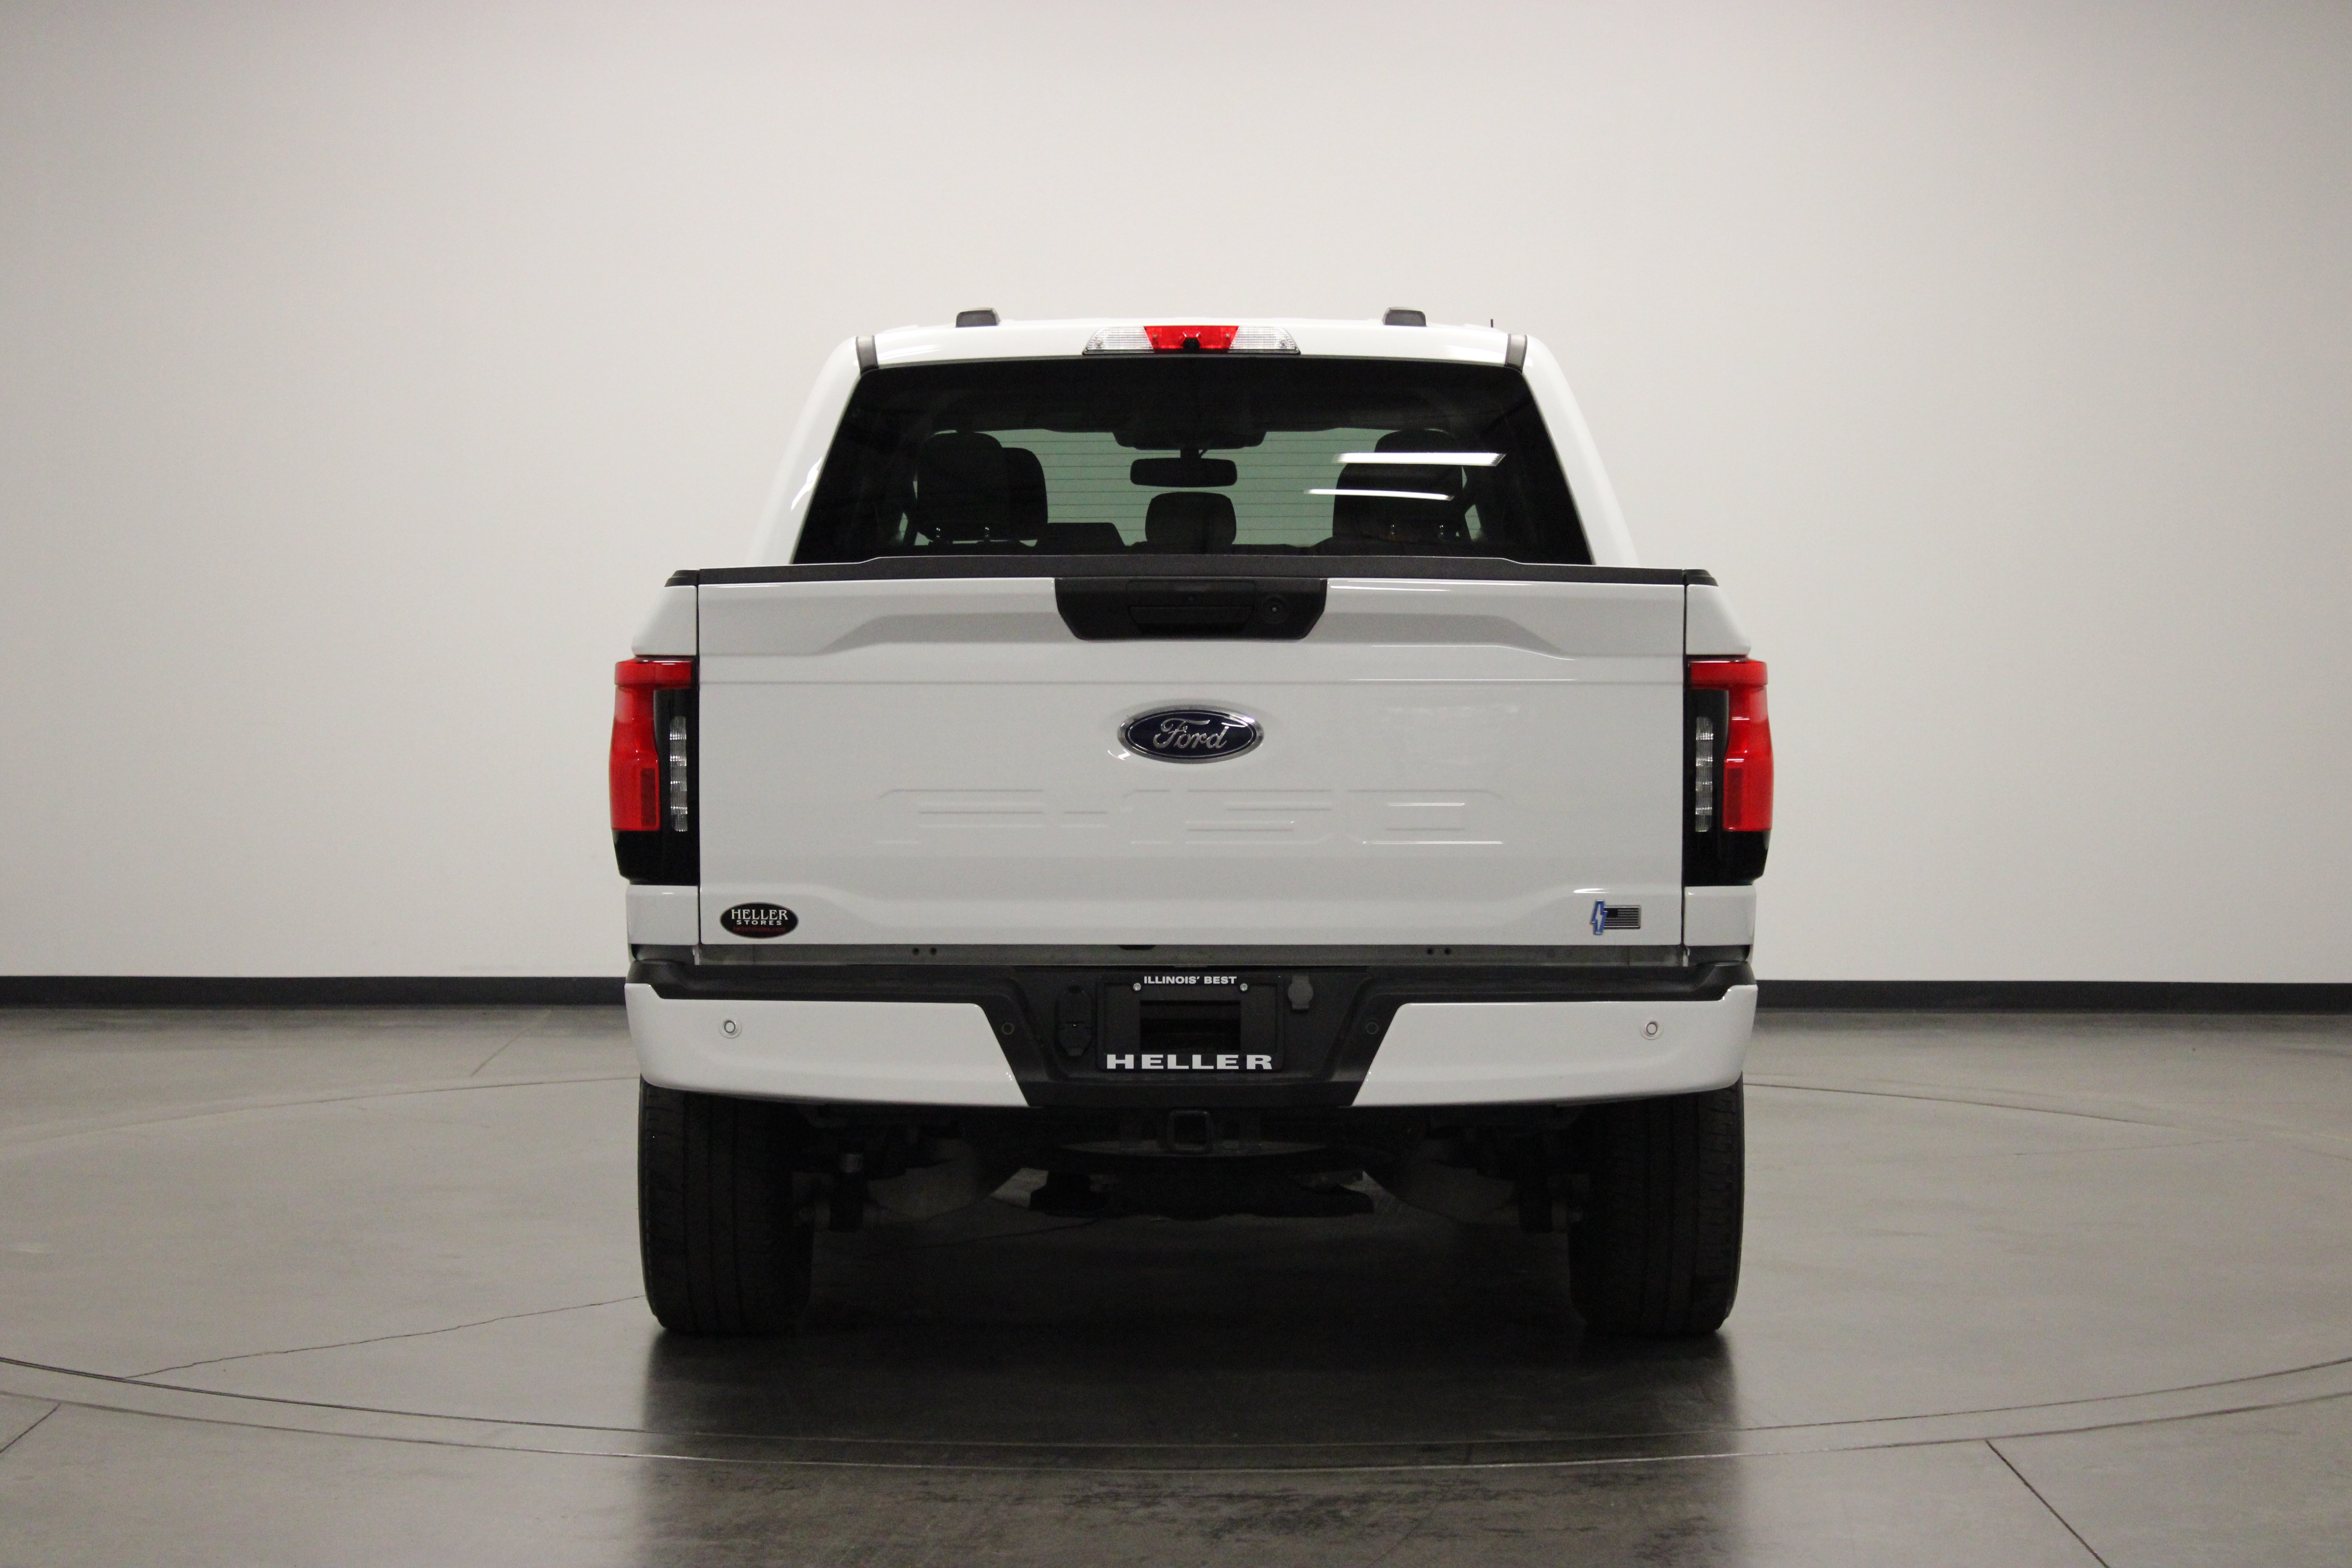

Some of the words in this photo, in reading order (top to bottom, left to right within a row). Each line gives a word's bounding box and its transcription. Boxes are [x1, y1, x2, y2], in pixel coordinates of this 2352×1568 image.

[1153, 718, 1229, 749] Ford
[731, 909, 788, 920] HELLER
[1144, 976, 1200, 984] ILLINOIS'
[1204, 976, 1237, 984] BEST
[1107, 1054, 1272, 1070] HELLER
